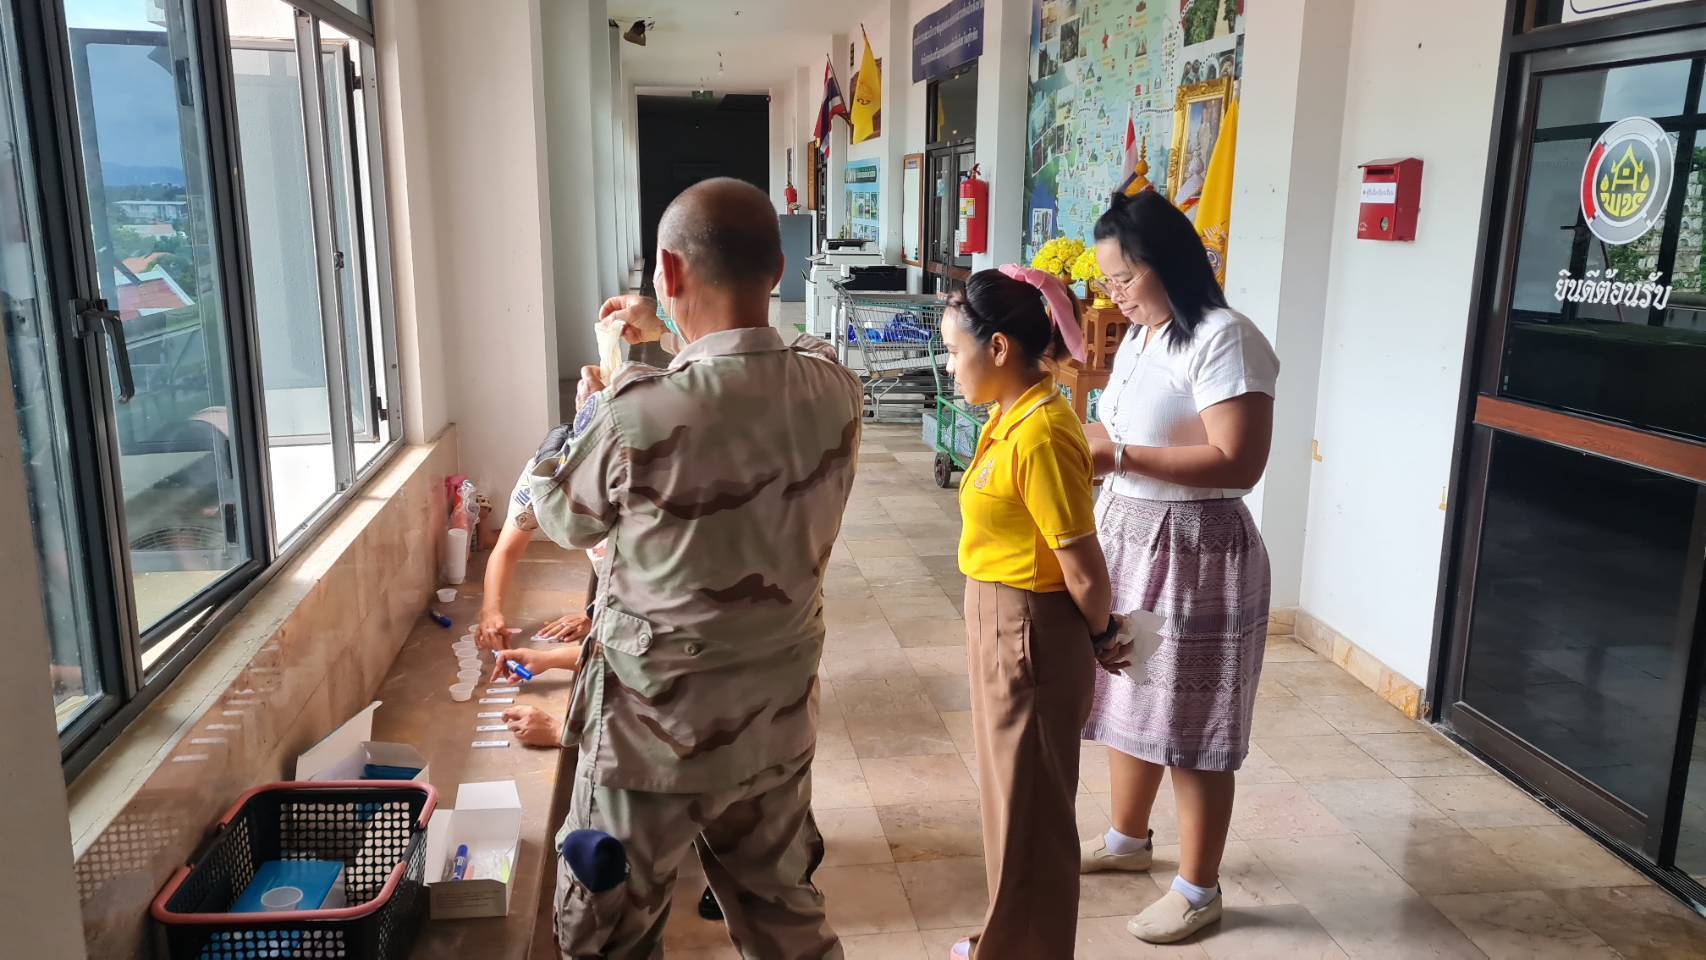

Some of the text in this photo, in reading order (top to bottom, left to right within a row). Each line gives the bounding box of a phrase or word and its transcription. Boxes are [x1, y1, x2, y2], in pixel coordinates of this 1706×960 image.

[1554, 268, 1673, 311] ยินดีต้อนรับ
